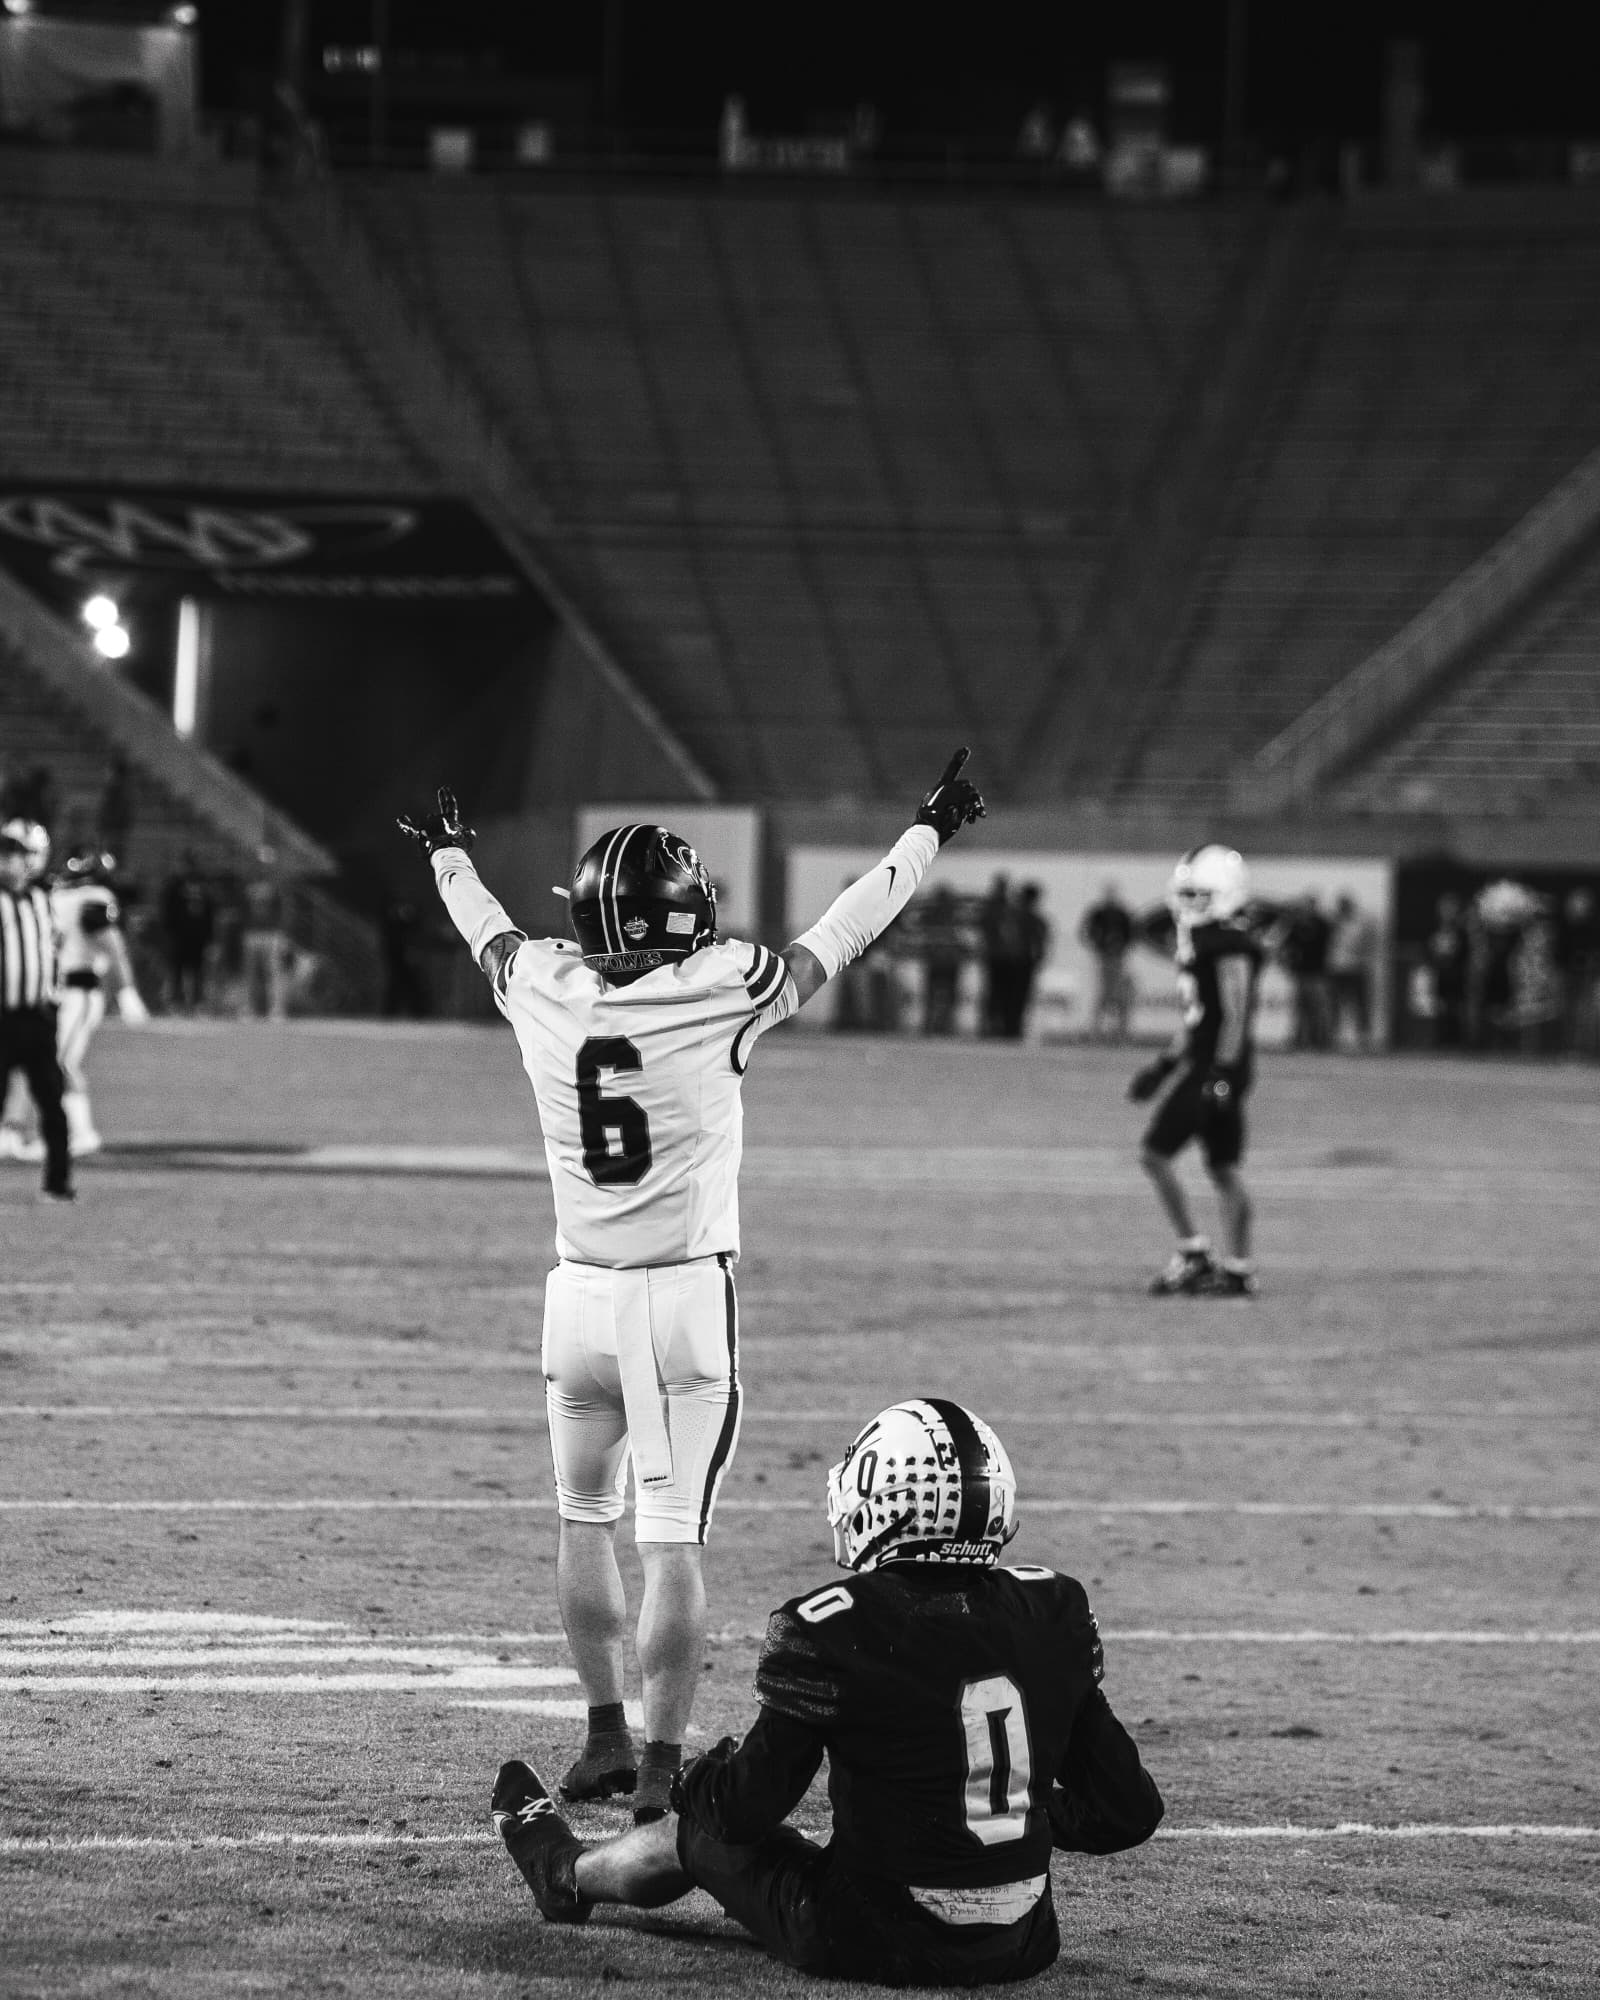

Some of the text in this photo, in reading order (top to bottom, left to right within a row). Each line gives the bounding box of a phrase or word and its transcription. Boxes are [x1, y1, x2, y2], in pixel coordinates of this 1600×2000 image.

[591, 951, 663, 970] WOLVES
[576, 1035, 653, 1186] 6
[857, 1450, 879, 1498] 0
[939, 1541, 992, 1556] schutt
[797, 1587, 854, 1623] 0
[960, 1675, 1031, 1846] 0
